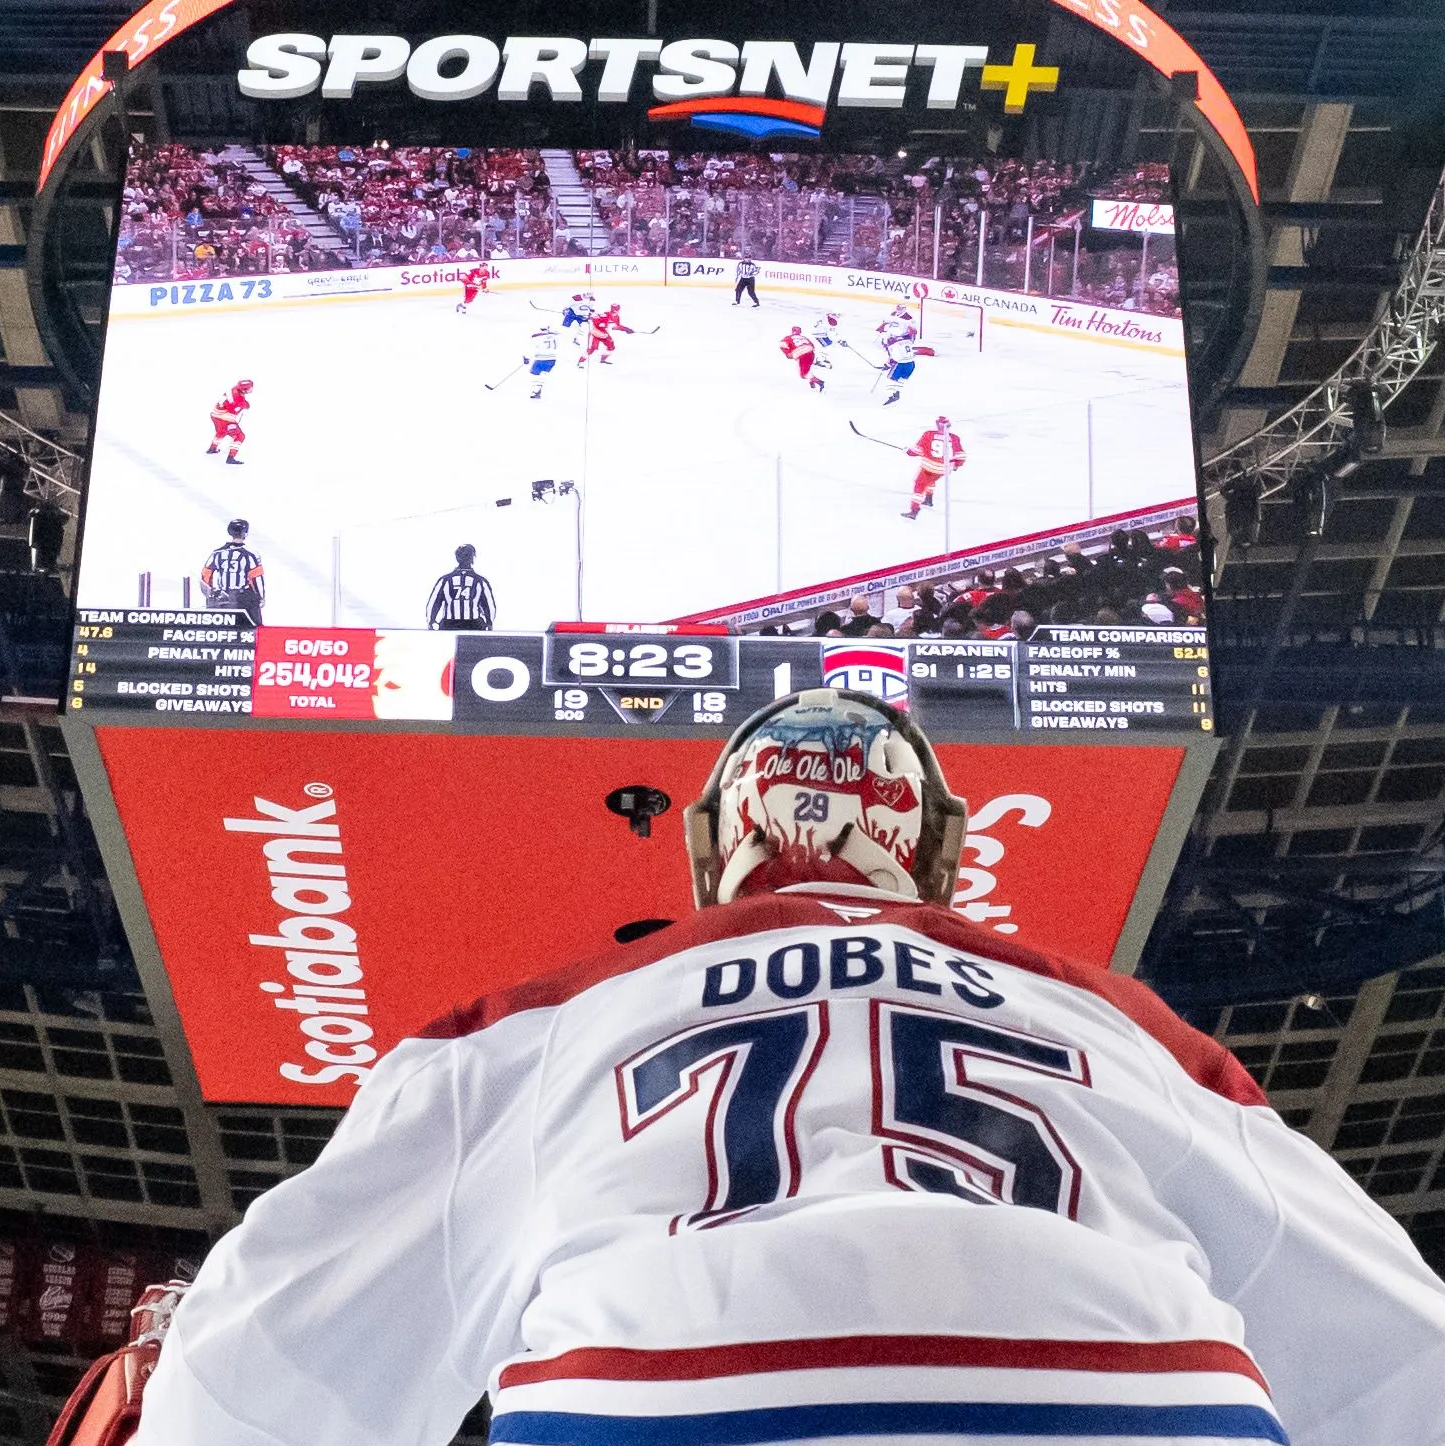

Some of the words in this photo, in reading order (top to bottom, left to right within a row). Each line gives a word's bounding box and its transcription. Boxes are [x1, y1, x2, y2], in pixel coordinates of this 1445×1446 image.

[238, 33, 1059, 114] SPORTSNET+
[400, 266, 501, 286] Scotiabk
[594, 264, 639, 273] ULTRA
[149, 284, 234, 306] PIZZA
[240, 279, 273, 300] 73
[847, 274, 912, 297] SAFEWAY
[961, 292, 980, 305] AIR
[983, 294, 1038, 315] CANADA
[1050, 304, 1086, 331] Tim
[1087, 310, 1164, 344] Hortons
[453, 586, 470, 600] 74
[80, 610, 123, 623] TEAM
[127, 611, 236, 626] COMPARISON
[163, 629, 239, 643] FACEOFF
[1050, 629, 1095, 643] TEAM
[1098, 630, 1206, 644] COMPARISON
[77, 645, 89, 656] 4
[148, 646, 221, 660] PENALTY
[224, 648, 255, 661] MIN
[284, 640, 349, 656] 50/50
[916, 645, 1008, 658] KAPANEN
[1028, 646, 1103, 659] FACEOFF
[1105, 647, 1120, 660] %
[568, 642, 713, 678] 8:23
[76, 662, 97, 674] 14
[215, 664, 253, 678] HITS
[258, 662, 371, 689] 254,042
[911, 664, 937, 678] 91
[956, 664, 1011, 679] 1:25
[1029, 664, 1102, 677] PENALTY
[1105, 665, 1136, 678] MIN
[73, 680, 84, 692] 5
[117, 681, 193, 695] BLOCKED
[196, 682, 252, 697] SHOTS
[1030, 680, 1067, 693] HITS
[1190, 683, 1206, 696] 11
[155, 698, 253, 713] GIVEAWAYS
[288, 695, 336, 709] TOTAL
[553, 689, 589, 709] 19
[620, 697, 664, 710] 2ND
[692, 692, 727, 712] 18
[1031, 700, 1106, 713] BLOCKED
[1108, 700, 1165, 714] SHOTS
[1192, 702, 1207, 714] 11
[554, 710, 584, 721] SOG
[693, 712, 723, 724] SOG
[1031, 716, 1129, 730] GIVEAWAYS
[793, 792, 830, 823] 29
[614, 1000, 1092, 1236] 75
